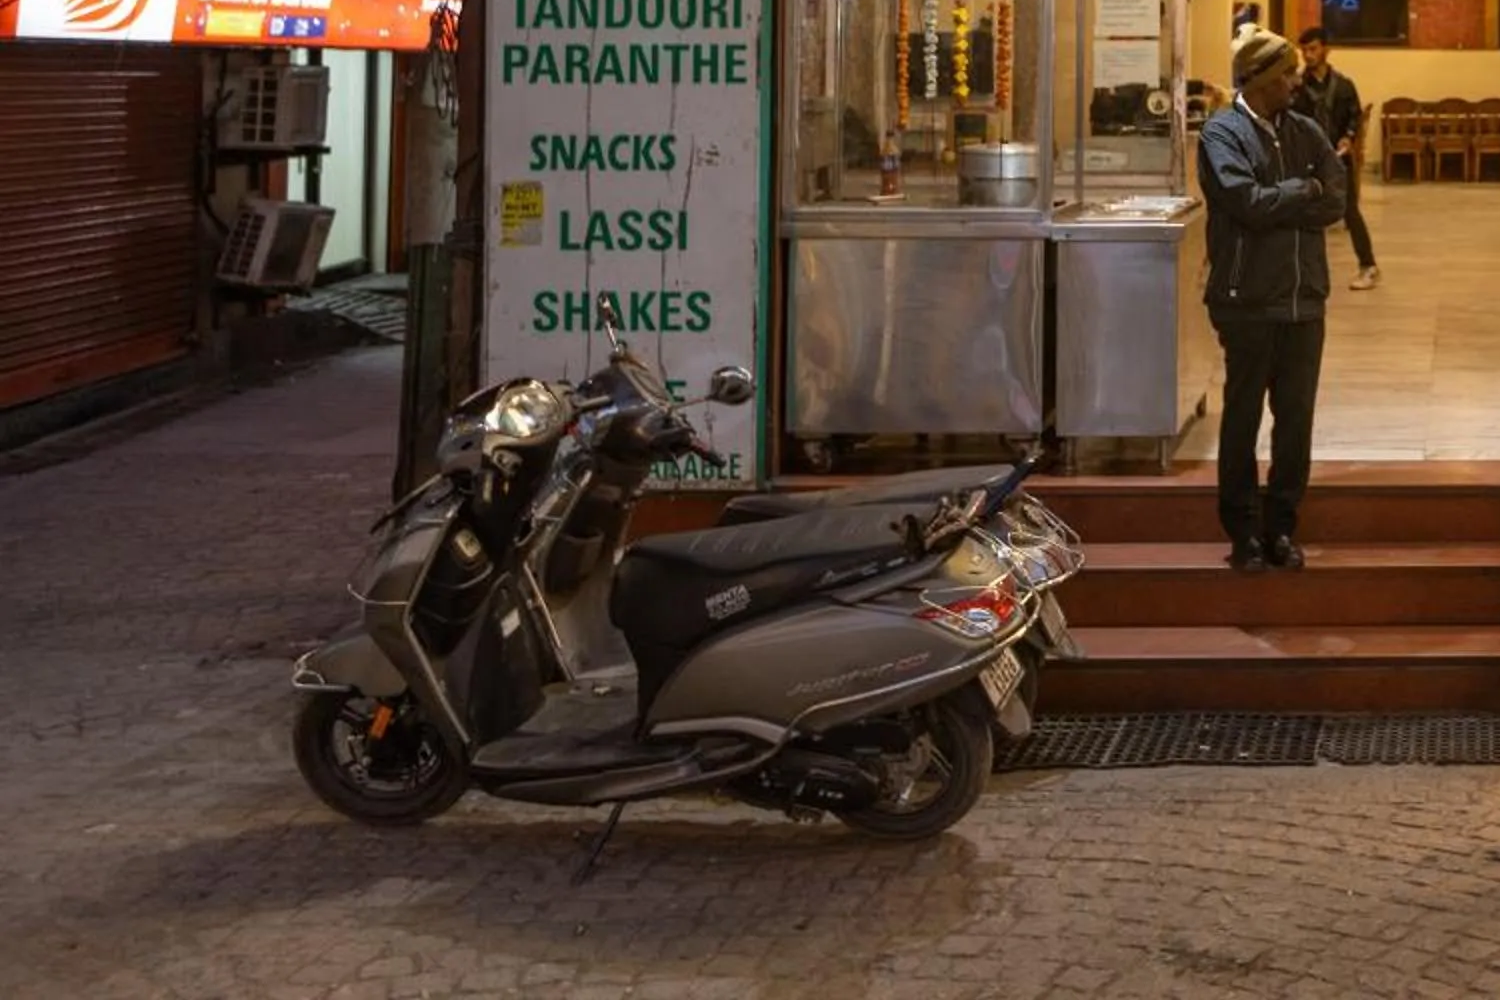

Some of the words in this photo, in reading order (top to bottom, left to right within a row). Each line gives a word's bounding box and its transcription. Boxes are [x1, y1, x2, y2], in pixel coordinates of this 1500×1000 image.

[503, 44, 748, 84] PARANTHE
[529, 134, 677, 171] SNACKS
[559, 210, 688, 250] LASSI
[532, 291, 712, 333] SHAKES
